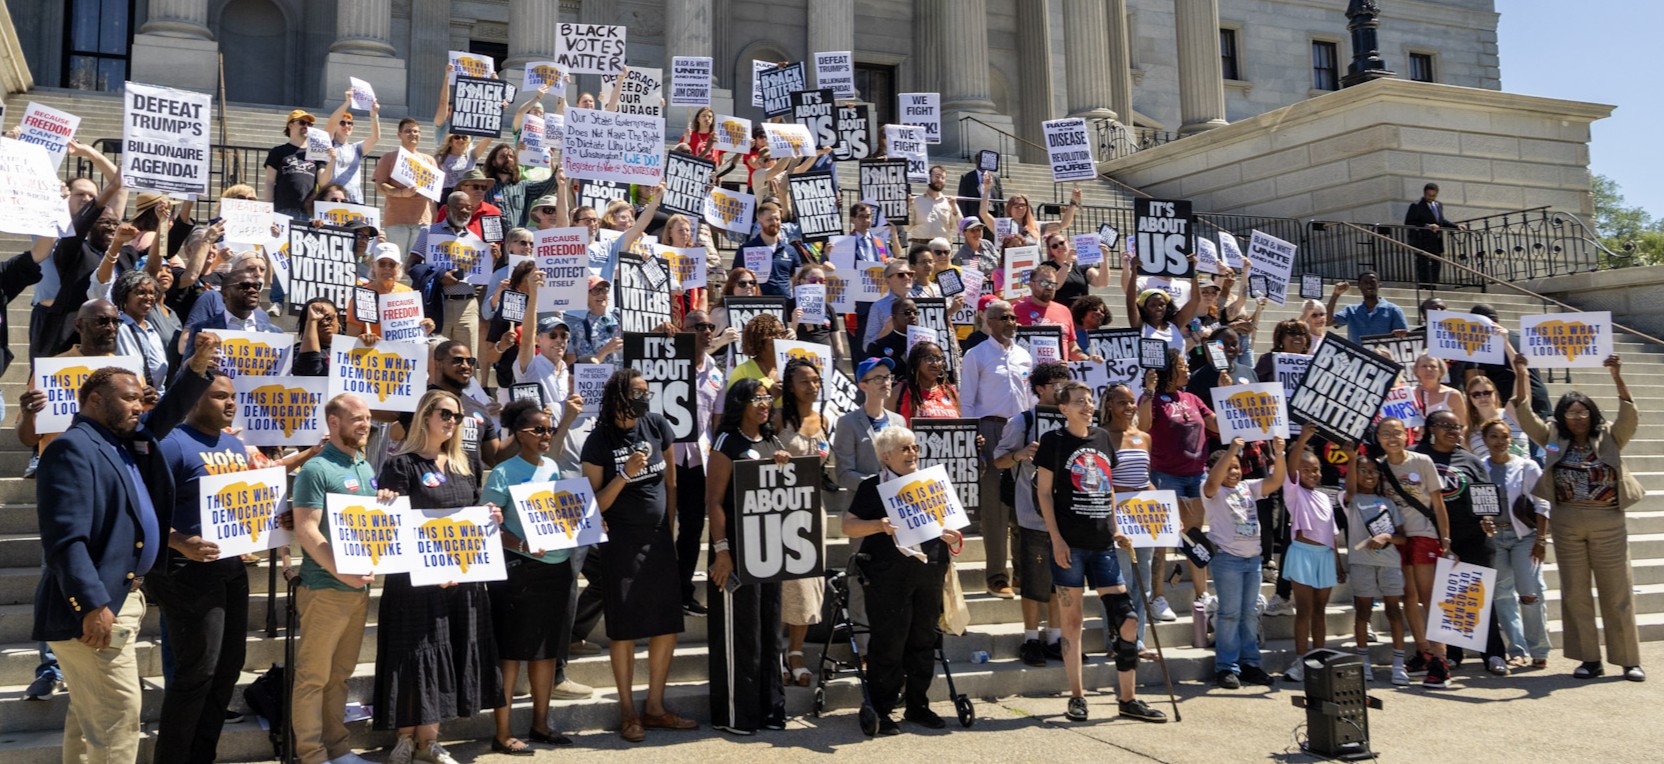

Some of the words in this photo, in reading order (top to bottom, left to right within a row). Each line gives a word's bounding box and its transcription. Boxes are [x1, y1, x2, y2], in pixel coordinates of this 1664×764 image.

[561, 23, 618, 38] BLACK
[566, 37, 624, 54] VOTES
[558, 54, 622, 72] MATTER
[818, 56, 848, 65] DEFEAT
[819, 65, 850, 73] TRUMP'S
[674, 88, 685, 97] JIM
[686, 88, 708, 98] CROW!
[802, 92, 822, 105] IT'S
[912, 96, 927, 104] WE
[134, 94, 202, 119] DEFEAT
[456, 97, 502, 116] VOTERS
[796, 103, 832, 118] ABOUT
[838, 108, 857, 119] IT'S
[907, 107, 934, 115] FIGHT
[34, 111, 70, 124] BECAUSE
[131, 113, 202, 136] TRUMP'S
[452, 112, 501, 131] MATTER
[571, 110, 586, 123] Our
[591, 112, 612, 125] State
[1046, 120, 1084, 129] RACISM
[25, 116, 72, 136] FREEDOM
[567, 126, 588, 137] Does
[607, 128, 625, 140] Have
[627, 130, 641, 141] The
[29, 128, 60, 141] CAN'T
[899, 129, 915, 140] WE
[1048, 131, 1086, 148] DISEASE
[18, 134, 64, 154] PROTECT
[128, 141, 203, 160] BILLIONAIRE
[576, 138, 604, 150] Dictate
[608, 140, 623, 150] Who
[894, 140, 920, 152] FIGHT
[624, 153, 640, 164] WE
[643, 154, 659, 166] DO!
[1052, 150, 1090, 162] REVOLUTION
[131, 158, 198, 179] AGENDA!
[1054, 162, 1092, 173] CURE!
[582, 184, 626, 199] ABOUT
[795, 197, 838, 216] VOTERS
[1149, 201, 1175, 217] IT'S
[799, 214, 842, 234] MATTER
[1138, 216, 1187, 234] ABOUT
[542, 234, 580, 244] BECAUSE
[1254, 235, 1270, 247] BLACK
[430, 244, 449, 254] THIS
[537, 244, 586, 258] FREEDOM
[1138, 232, 1189, 275] US
[1252, 244, 1290, 264] UNITE
[433, 253, 482, 266] DEMOCRACY
[546, 257, 578, 266] CAN'T
[291, 256, 356, 286] VOTERS
[548, 280, 575, 288] ITSELF
[387, 299, 414, 307] BECAUSE
[621, 287, 670, 314] VOTERS
[383, 306, 419, 320] FREEDOM
[390, 319, 415, 328] CAN'T
[1432, 320, 1453, 332] THIS
[1456, 322, 1467, 332] IS
[1524, 326, 1548, 336] THIS
[1553, 326, 1564, 335] IS
[1570, 325, 1600, 334] WHAT
[384, 326, 421, 340] PROTECT
[1436, 330, 1492, 344] DEMOCRACY
[644, 337, 676, 358] IT'S
[1439, 339, 1468, 350] LOOKS
[1472, 342, 1492, 354] LIKE
[1529, 336, 1596, 346] DEMOCRACY
[255, 346, 283, 359] WHAT
[1037, 347, 1054, 355] KEEP
[1533, 346, 1567, 356] LOOKS
[1573, 346, 1598, 355] LIKE
[337, 352, 361, 366] THIS
[367, 353, 378, 367] IS
[385, 354, 418, 370] WHAT
[1142, 357, 1165, 366] MATTER
[42, 374, 70, 387] THIS
[340, 366, 412, 383] DEMOCRACY
[343, 380, 380, 394] LOOKS
[386, 382, 412, 397] LIKE
[1305, 365, 1383, 418] VOTERS
[240, 392, 266, 405] THIS
[290, 392, 322, 404] WHAT
[1219, 399, 1243, 411] THIS
[1246, 398, 1256, 408] IS
[1259, 395, 1280, 406] WHAT
[244, 405, 317, 418] DEMOCRACY
[1225, 407, 1280, 421] DEMOCRACY
[1290, 385, 1371, 441] MATTER
[248, 418, 286, 431] LOOKS
[292, 418, 317, 430] LIKE
[1231, 418, 1262, 430] LOOKS
[198, 450, 246, 466] vote
[759, 462, 797, 488] IT'S
[207, 492, 232, 509] THIS
[238, 490, 248, 505] IS
[254, 485, 279, 502] WHAT
[520, 498, 542, 512] THIS
[558, 492, 587, 508] WHAT
[743, 486, 815, 514] ABOUT
[888, 492, 914, 510] THIS
[916, 487, 927, 499] IS
[1471, 495, 1498, 505] VOTERS
[212, 501, 277, 525] DEMOCRACY
[897, 491, 951, 520] DEMOCRACY
[1148, 503, 1172, 514] WHAT
[1472, 504, 1500, 513] MATTER
[332, 512, 354, 527] THIS
[357, 513, 367, 527] IS
[371, 514, 402, 528] WHAT
[528, 504, 587, 524] DEMOCRACY
[906, 510, 939, 531] LOOKS
[1115, 514, 1171, 526] DEMOCRACY
[218, 521, 252, 540] LOOKS
[258, 516, 279, 532] LIKE
[339, 526, 399, 542] DEMOCRACY
[460, 524, 491, 539] WHAT
[535, 522, 566, 536] LOOKS
[570, 518, 592, 532] LIKE
[1122, 524, 1151, 535] LOOKS
[1154, 524, 1173, 534] LIKE
[344, 542, 372, 557] LOOKS
[376, 542, 402, 556] LIKE
[417, 538, 488, 553] DEMOCRACY
[743, 510, 817, 579] US
[424, 553, 461, 568] LOOKS
[466, 552, 490, 566] LIKE
[1445, 573, 1456, 605] LOOKS
[1470, 571, 1482, 593] THIS
[1453, 572, 1471, 633] DEMOCRACY
[1441, 609, 1453, 630] LIKE
[1463, 612, 1476, 640] WHAT
